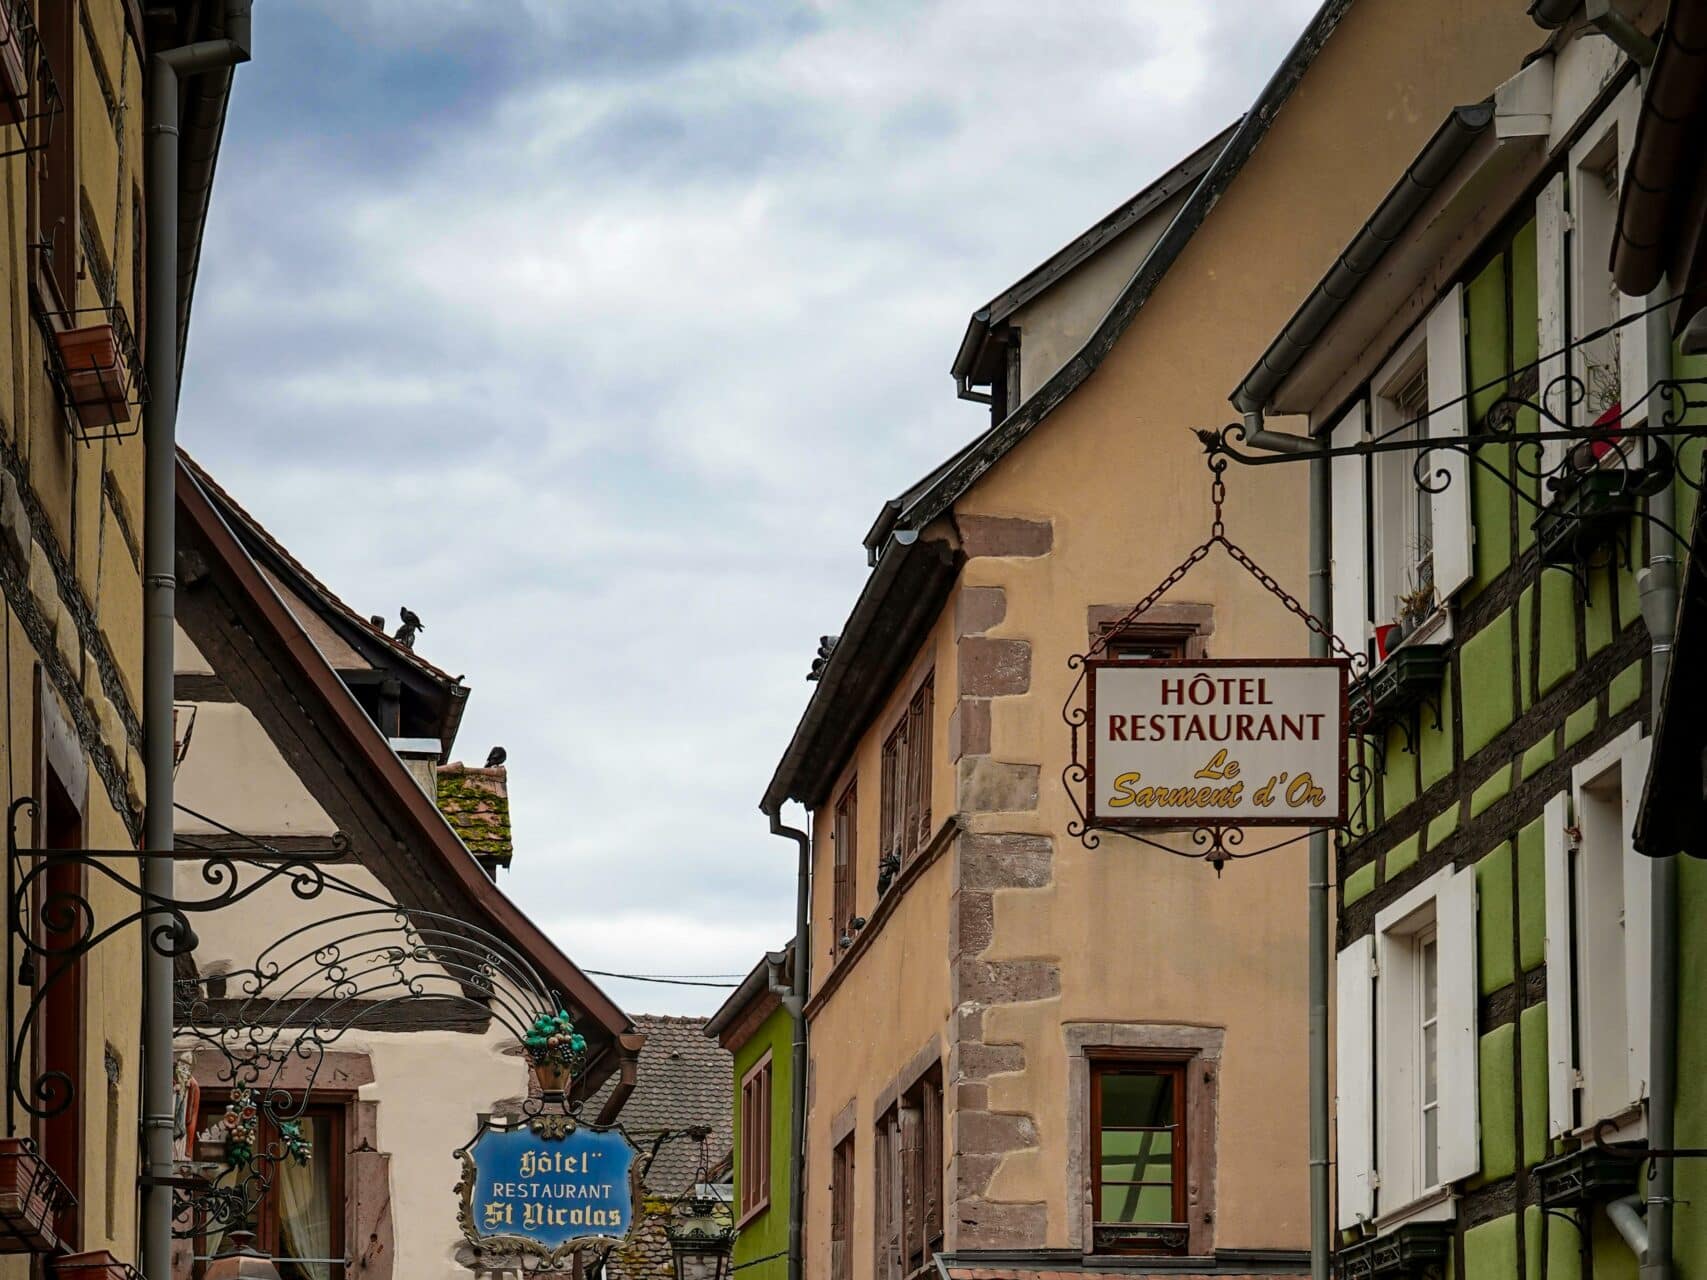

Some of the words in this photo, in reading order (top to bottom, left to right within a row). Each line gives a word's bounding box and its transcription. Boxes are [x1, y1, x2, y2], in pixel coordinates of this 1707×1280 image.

[1161, 672, 1273, 705] HÔTEL
[1108, 714, 1326, 742] RESTAURANT
[1194, 748, 1241, 780] Le
[1108, 772, 1244, 808] Sarment
[1252, 772, 1327, 808] d'Or
[519, 1150, 589, 1179] Hôtel
[493, 1182, 613, 1199] RESTAURANT
[483, 1201, 513, 1229] St
[522, 1202, 621, 1230] Nicolas
